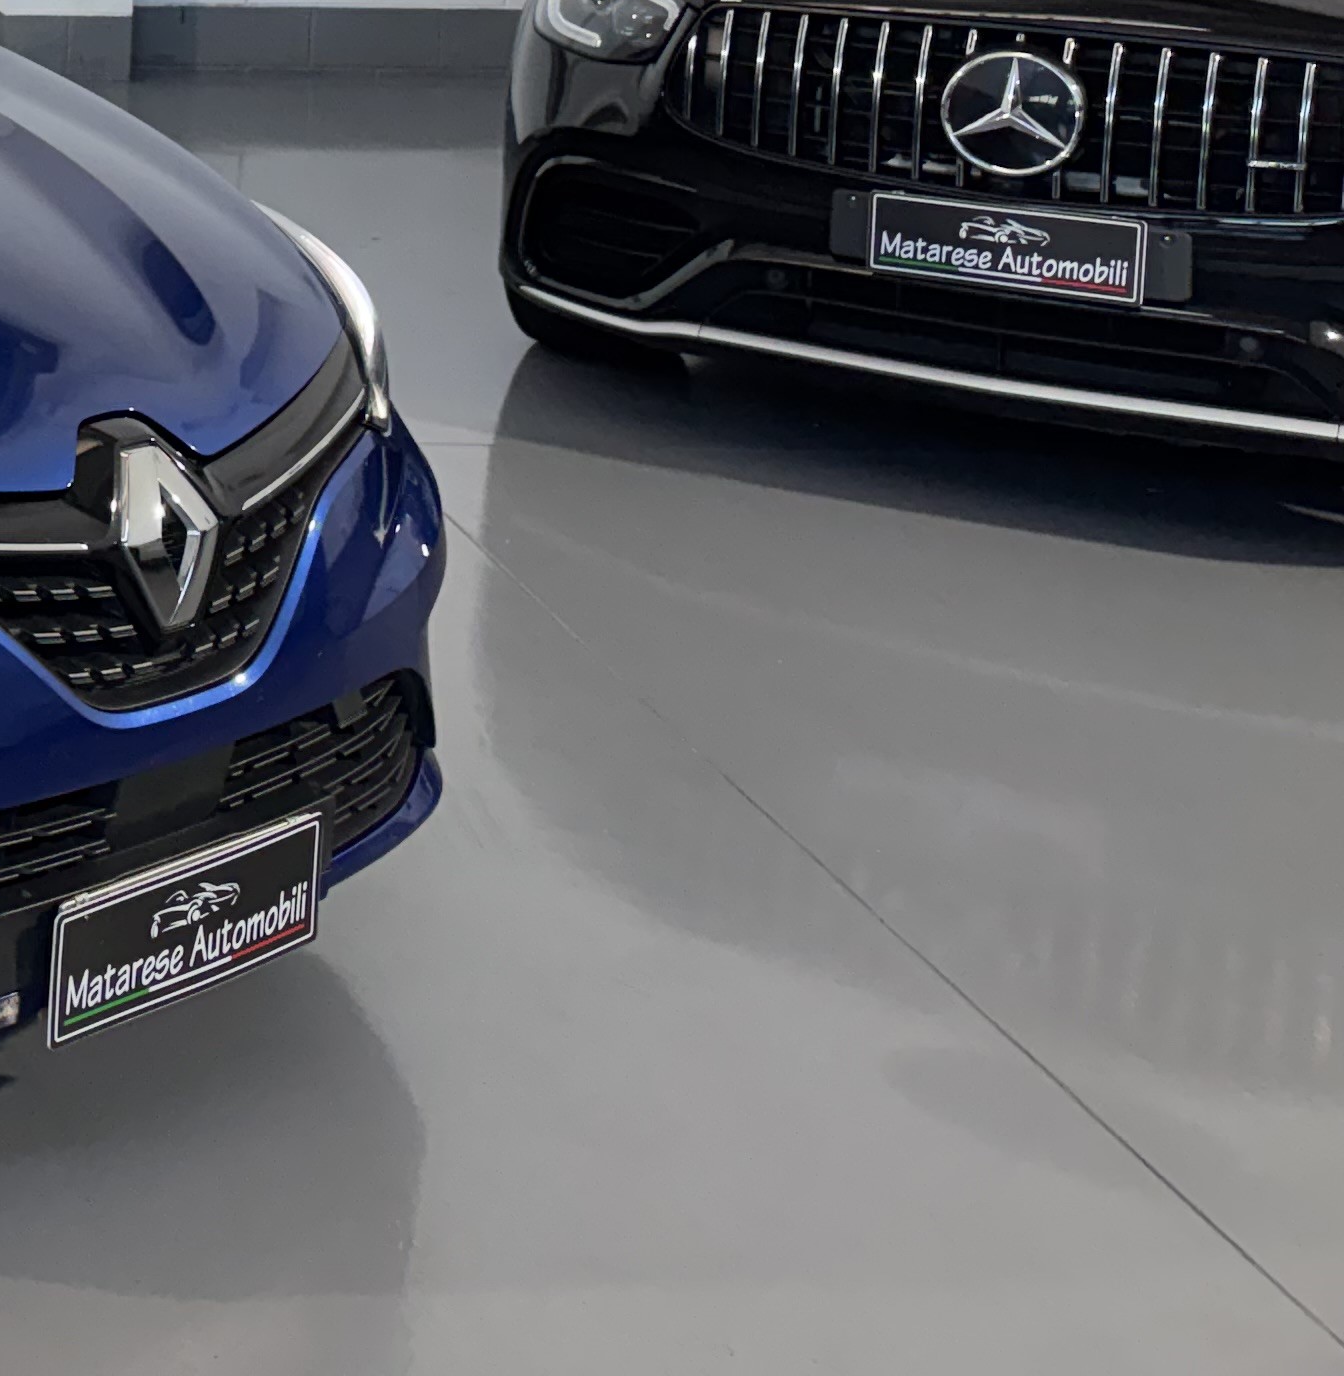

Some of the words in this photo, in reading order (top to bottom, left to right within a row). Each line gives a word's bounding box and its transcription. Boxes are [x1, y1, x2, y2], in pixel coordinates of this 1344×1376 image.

[880, 229, 993, 270] Matarese
[997, 245, 1129, 287] Automobili
[65, 944, 184, 1016] Matarese
[188, 880, 309, 968] Automobili
